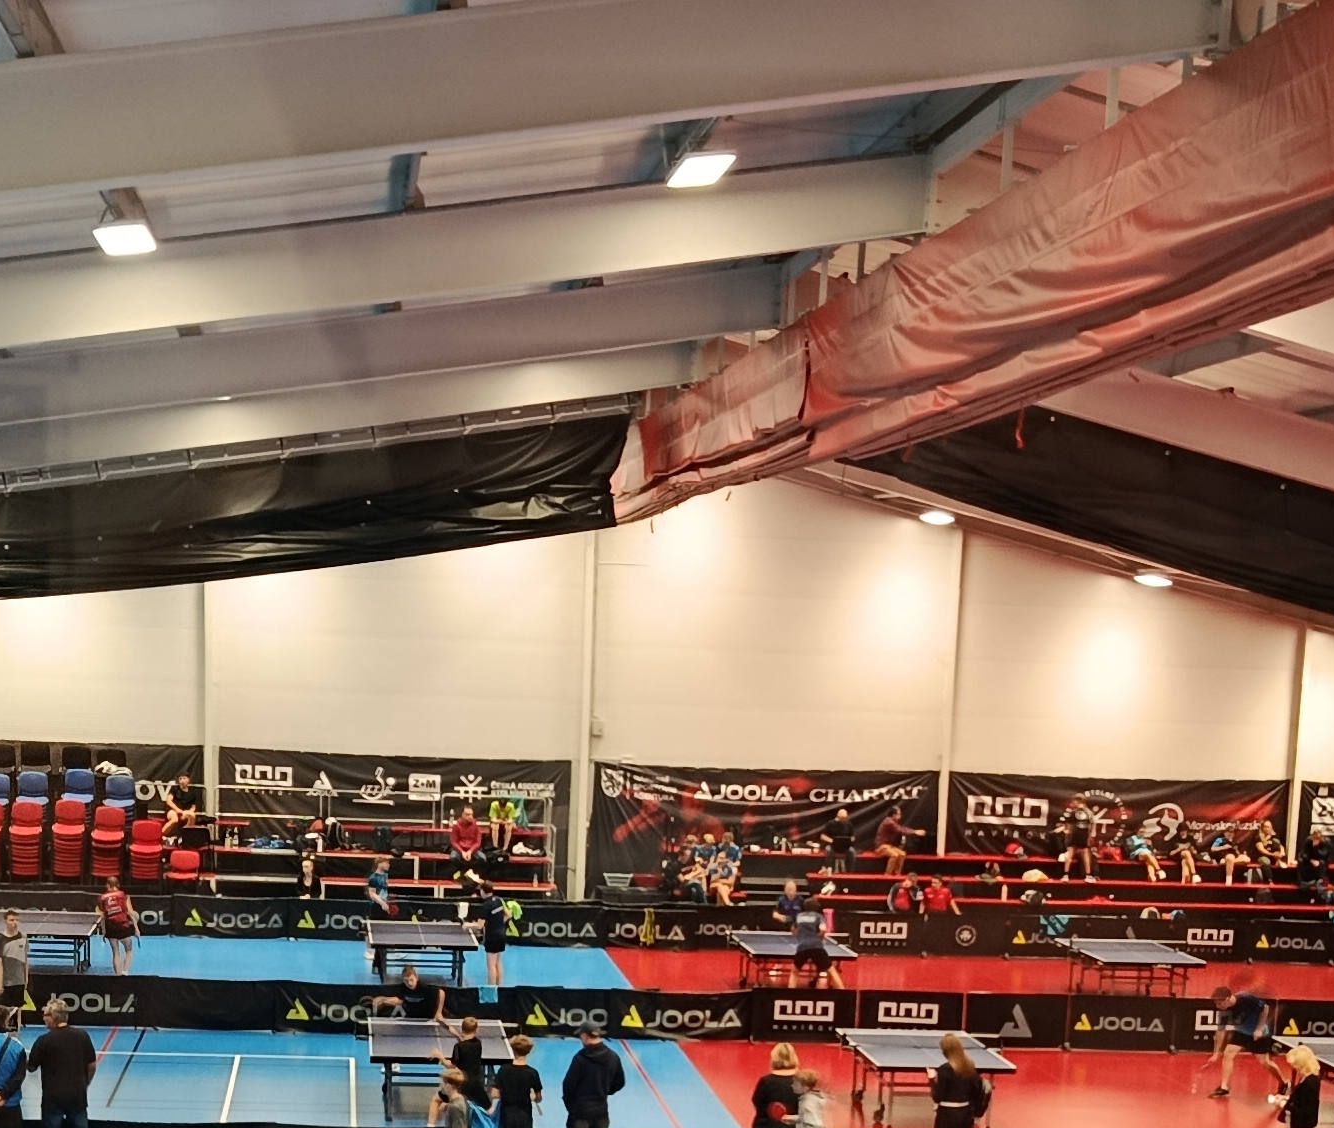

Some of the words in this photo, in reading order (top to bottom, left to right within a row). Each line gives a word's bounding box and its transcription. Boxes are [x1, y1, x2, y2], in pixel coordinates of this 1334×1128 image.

[412, 778, 437, 789] Z+M
[717, 784, 792, 802] JOOLA
[206, 912, 284, 929] JOOLA
[522, 921, 598, 938] JOOLA
[1270, 936, 1326, 950] JOOLA
[647, 1009, 742, 1029] JOOLA
[1093, 1016, 1165, 1032] JOOLA
